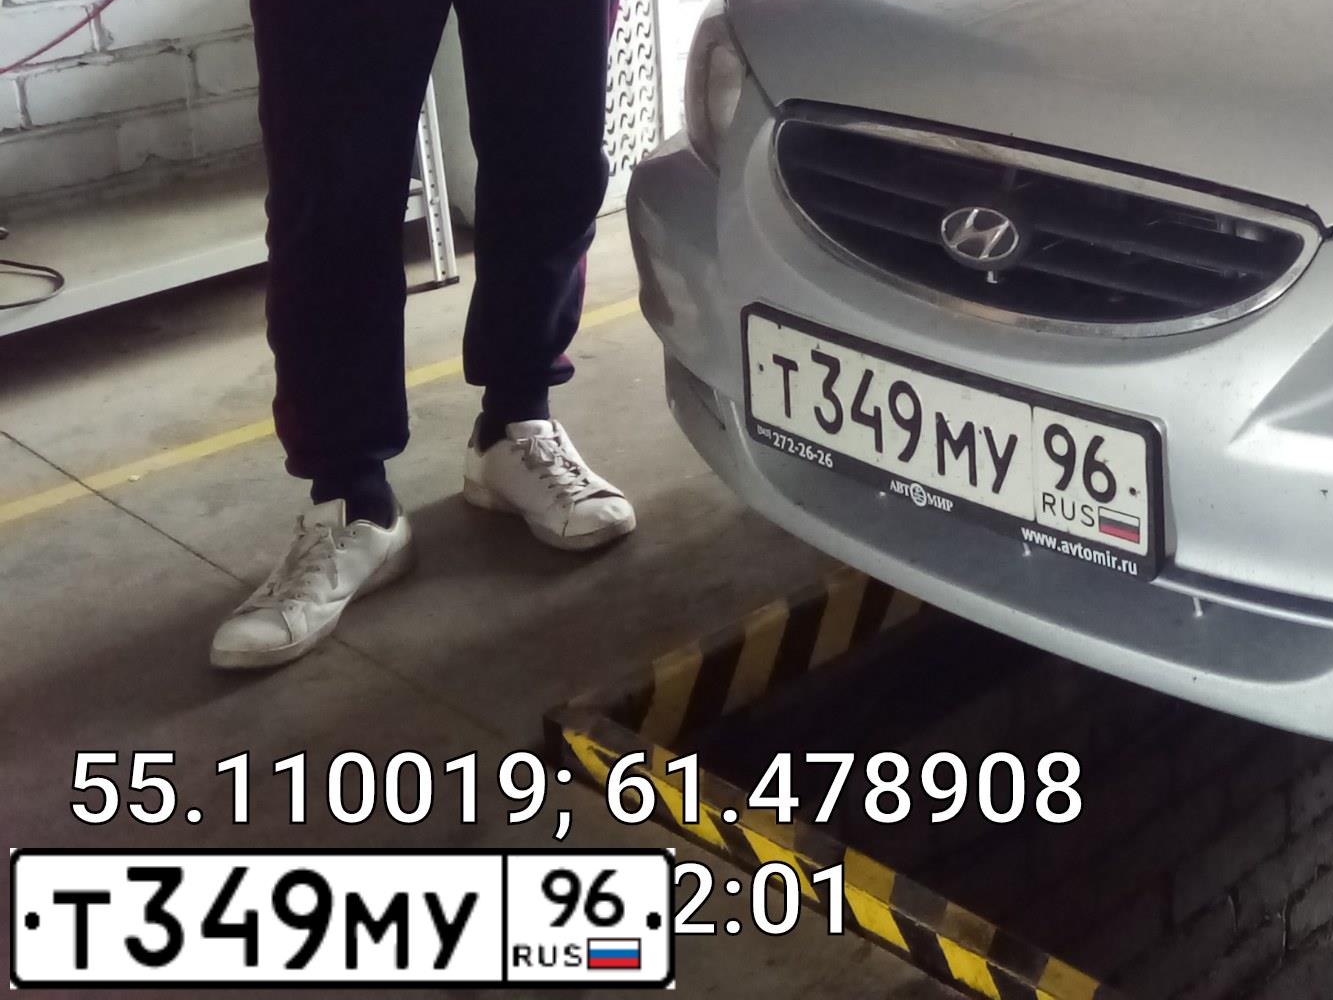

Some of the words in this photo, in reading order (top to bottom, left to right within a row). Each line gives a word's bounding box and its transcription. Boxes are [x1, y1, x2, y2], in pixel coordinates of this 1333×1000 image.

[773, 432, 833, 468] 272-26-26
[1043, 423, 1117, 503] 96
[1042, 492, 1095, 528] RUS
[1021, 527, 1137, 576] www.avtomir.ru
